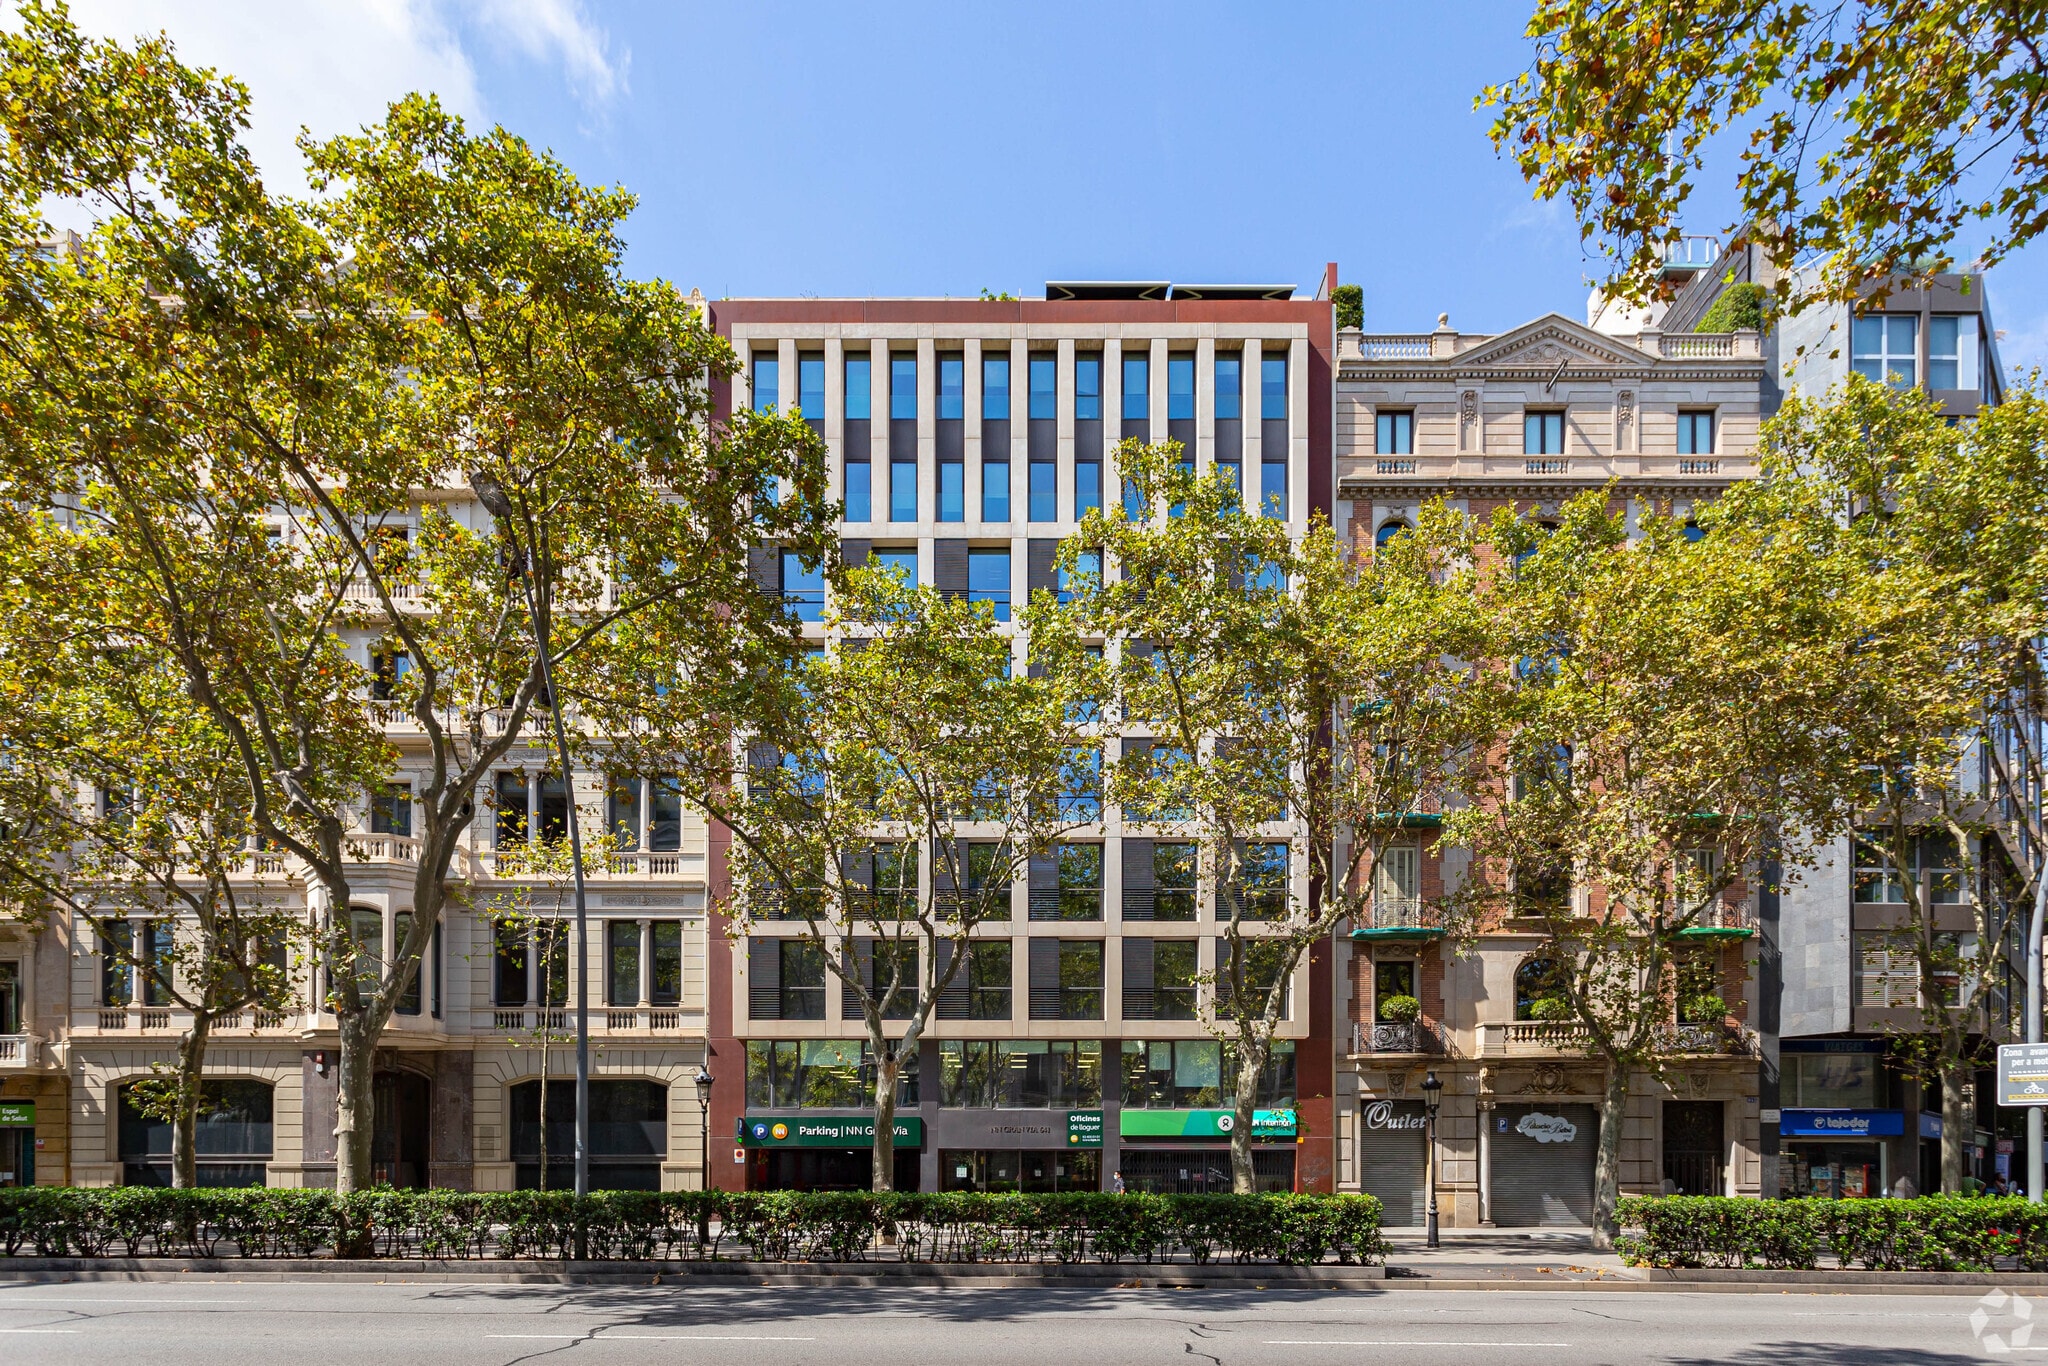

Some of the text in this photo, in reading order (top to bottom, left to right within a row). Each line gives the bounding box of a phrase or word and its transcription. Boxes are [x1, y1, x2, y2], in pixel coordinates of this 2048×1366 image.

[2003, 1048, 2023, 1057] Zona
[2012, 1059, 2025, 1068] per
[1364, 1100, 1426, 1129] Outlet
[800, 1126, 838, 1137] Parking
[846, 1126, 863, 1135] NN
[892, 1126, 908, 1135] Via
[1079, 1124, 1100, 1132] lloguer
